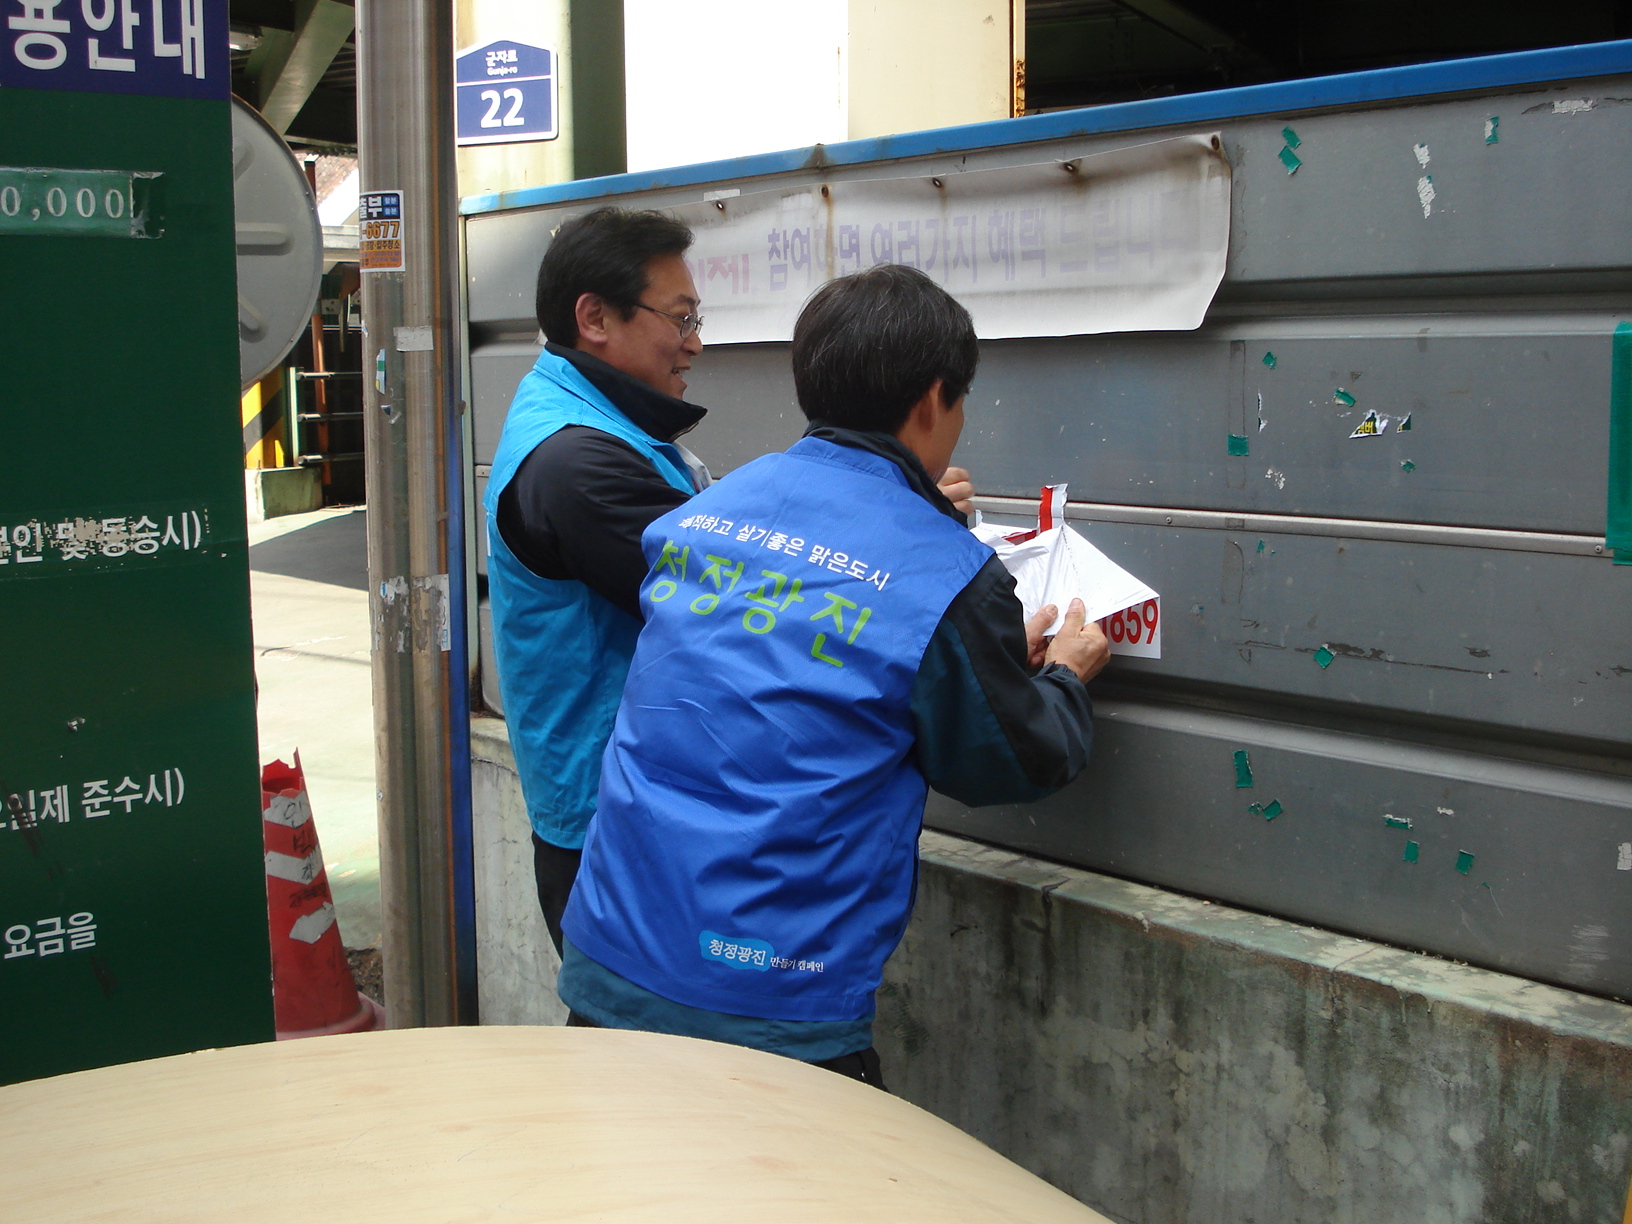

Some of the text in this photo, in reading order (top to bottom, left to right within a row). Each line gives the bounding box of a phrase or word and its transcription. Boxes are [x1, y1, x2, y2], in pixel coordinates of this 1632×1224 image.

[485, 49, 518, 67] 군자로
[480, 87, 525, 128] 22
[1, 187, 124, 220] 0,000
[987, 206, 1047, 281] 혜택
[735, 523, 805, 557] 살기좋은
[807, 543, 890, 592] 맑은도시
[649, 539, 873, 668] 청정광진
[0, 767, 185, 831] 일제 준수시)
[4, 911, 98, 959] 요금을
[708, 939, 767, 966] 청정광진
